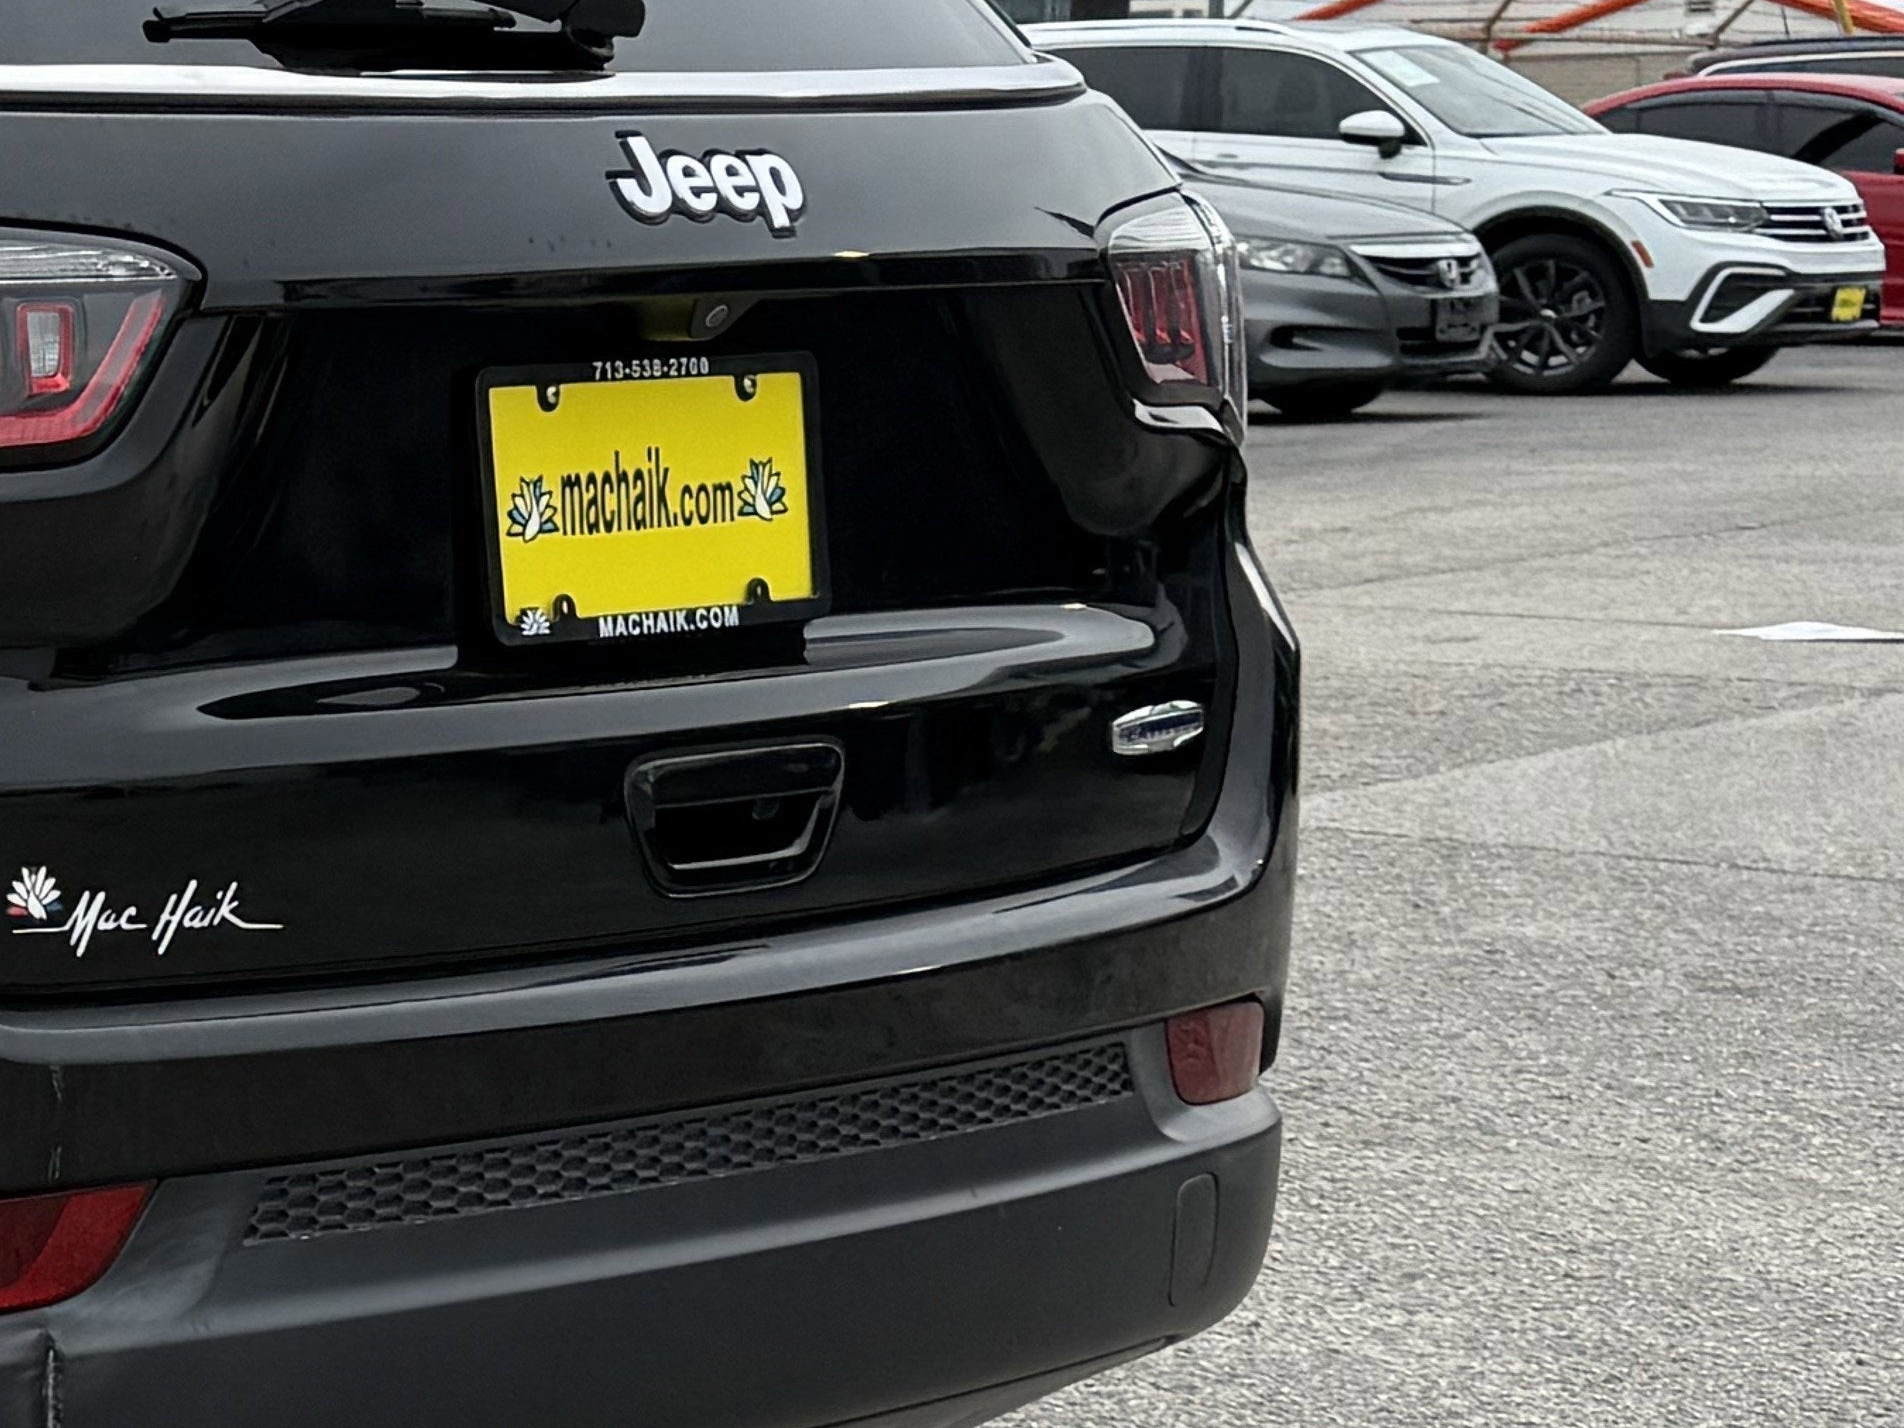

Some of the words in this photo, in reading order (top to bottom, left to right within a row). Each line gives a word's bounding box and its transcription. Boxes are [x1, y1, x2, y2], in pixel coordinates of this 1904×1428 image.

[606, 130, 807, 238] Jeep
[560, 445, 735, 536] machaik.com
[599, 605, 740, 639] MACHAIK.COM
[12, 890, 148, 958] Mac
[152, 878, 284, 955] Haik
